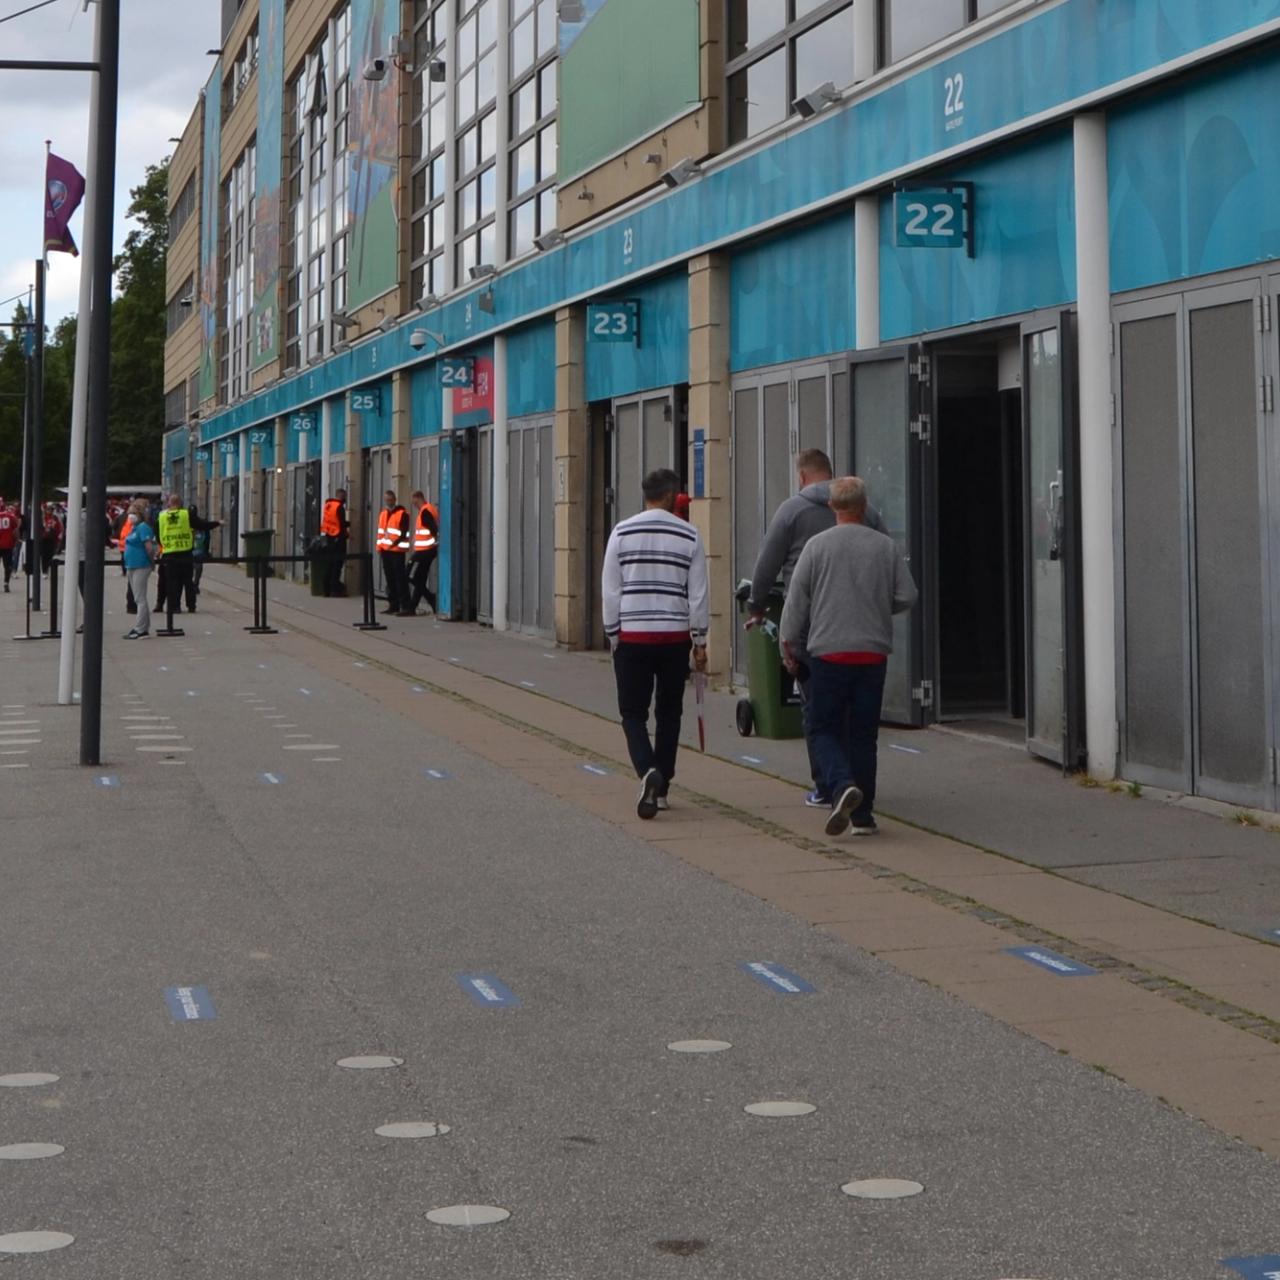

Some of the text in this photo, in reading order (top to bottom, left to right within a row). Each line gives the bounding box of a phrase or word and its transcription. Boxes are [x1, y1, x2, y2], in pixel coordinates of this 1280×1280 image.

[944, 72, 964, 117] 22
[905, 203, 955, 236] 22
[623, 227, 634, 256] 23
[594, 312, 628, 335] 23
[441, 366, 468, 383] 24
[352, 395, 374, 409] 25
[293, 418, 311, 430] 26
[251, 432, 266, 443] 27
[220, 443, 234, 453] 28
[196, 451, 209, 461] 29
